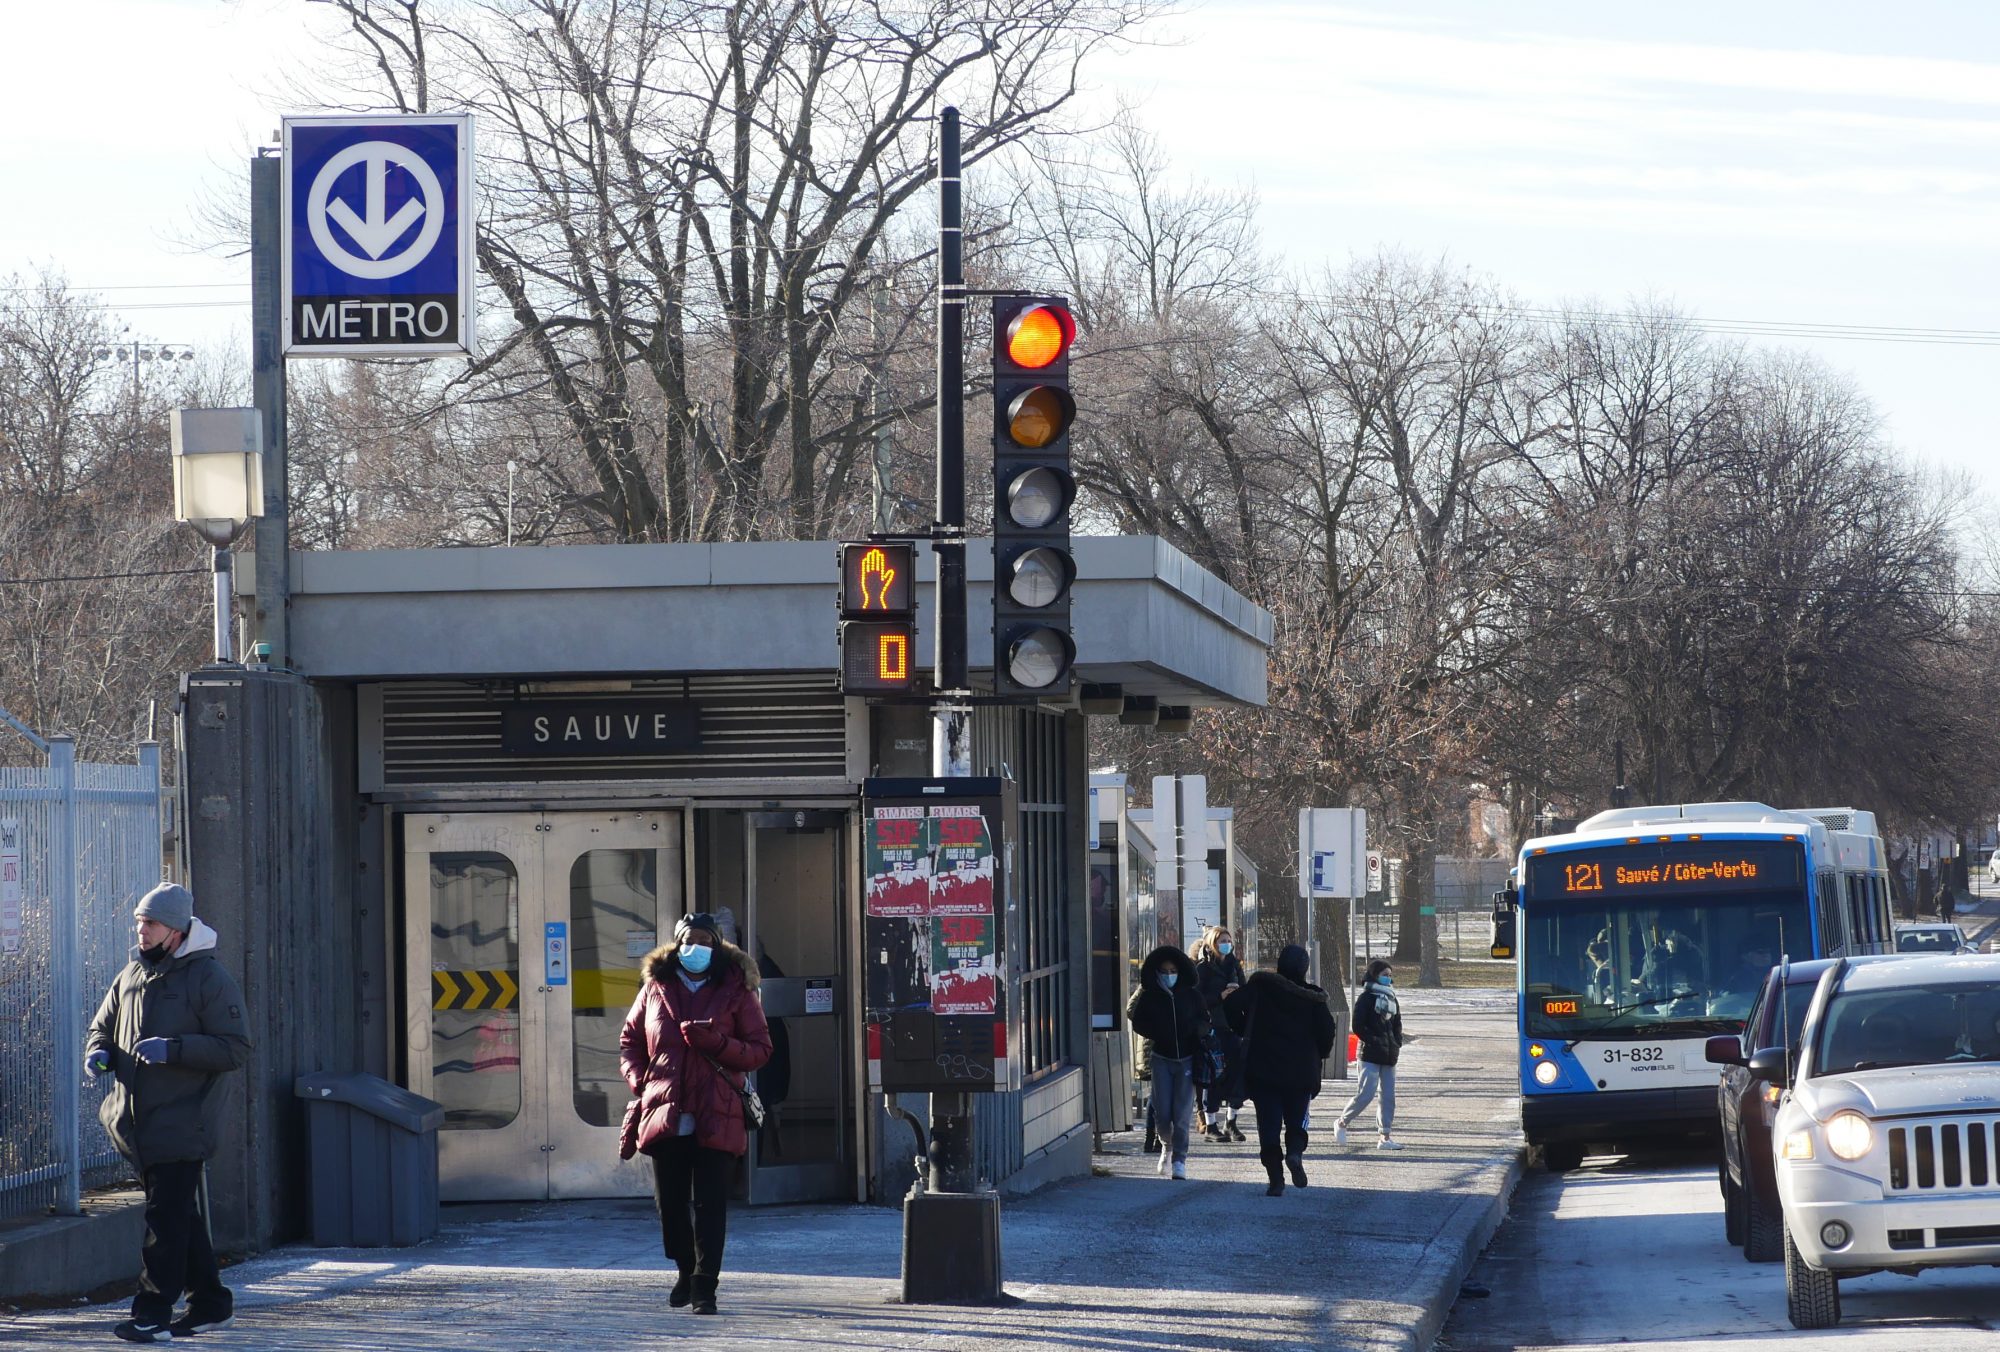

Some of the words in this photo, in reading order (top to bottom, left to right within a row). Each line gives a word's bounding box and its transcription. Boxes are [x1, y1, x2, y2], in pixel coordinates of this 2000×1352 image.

[302, 300, 449, 338] MÉTRO
[880, 635, 906, 679] 0
[534, 714, 666, 742] SAUVE
[1565, 863, 1602, 891] 121
[1616, 865, 1660, 884] Sauvé
[1674, 860, 1757, 881] Côte-Vertu
[1546, 1001, 1577, 1014] 0021
[1603, 1047, 1664, 1063] 31-832
